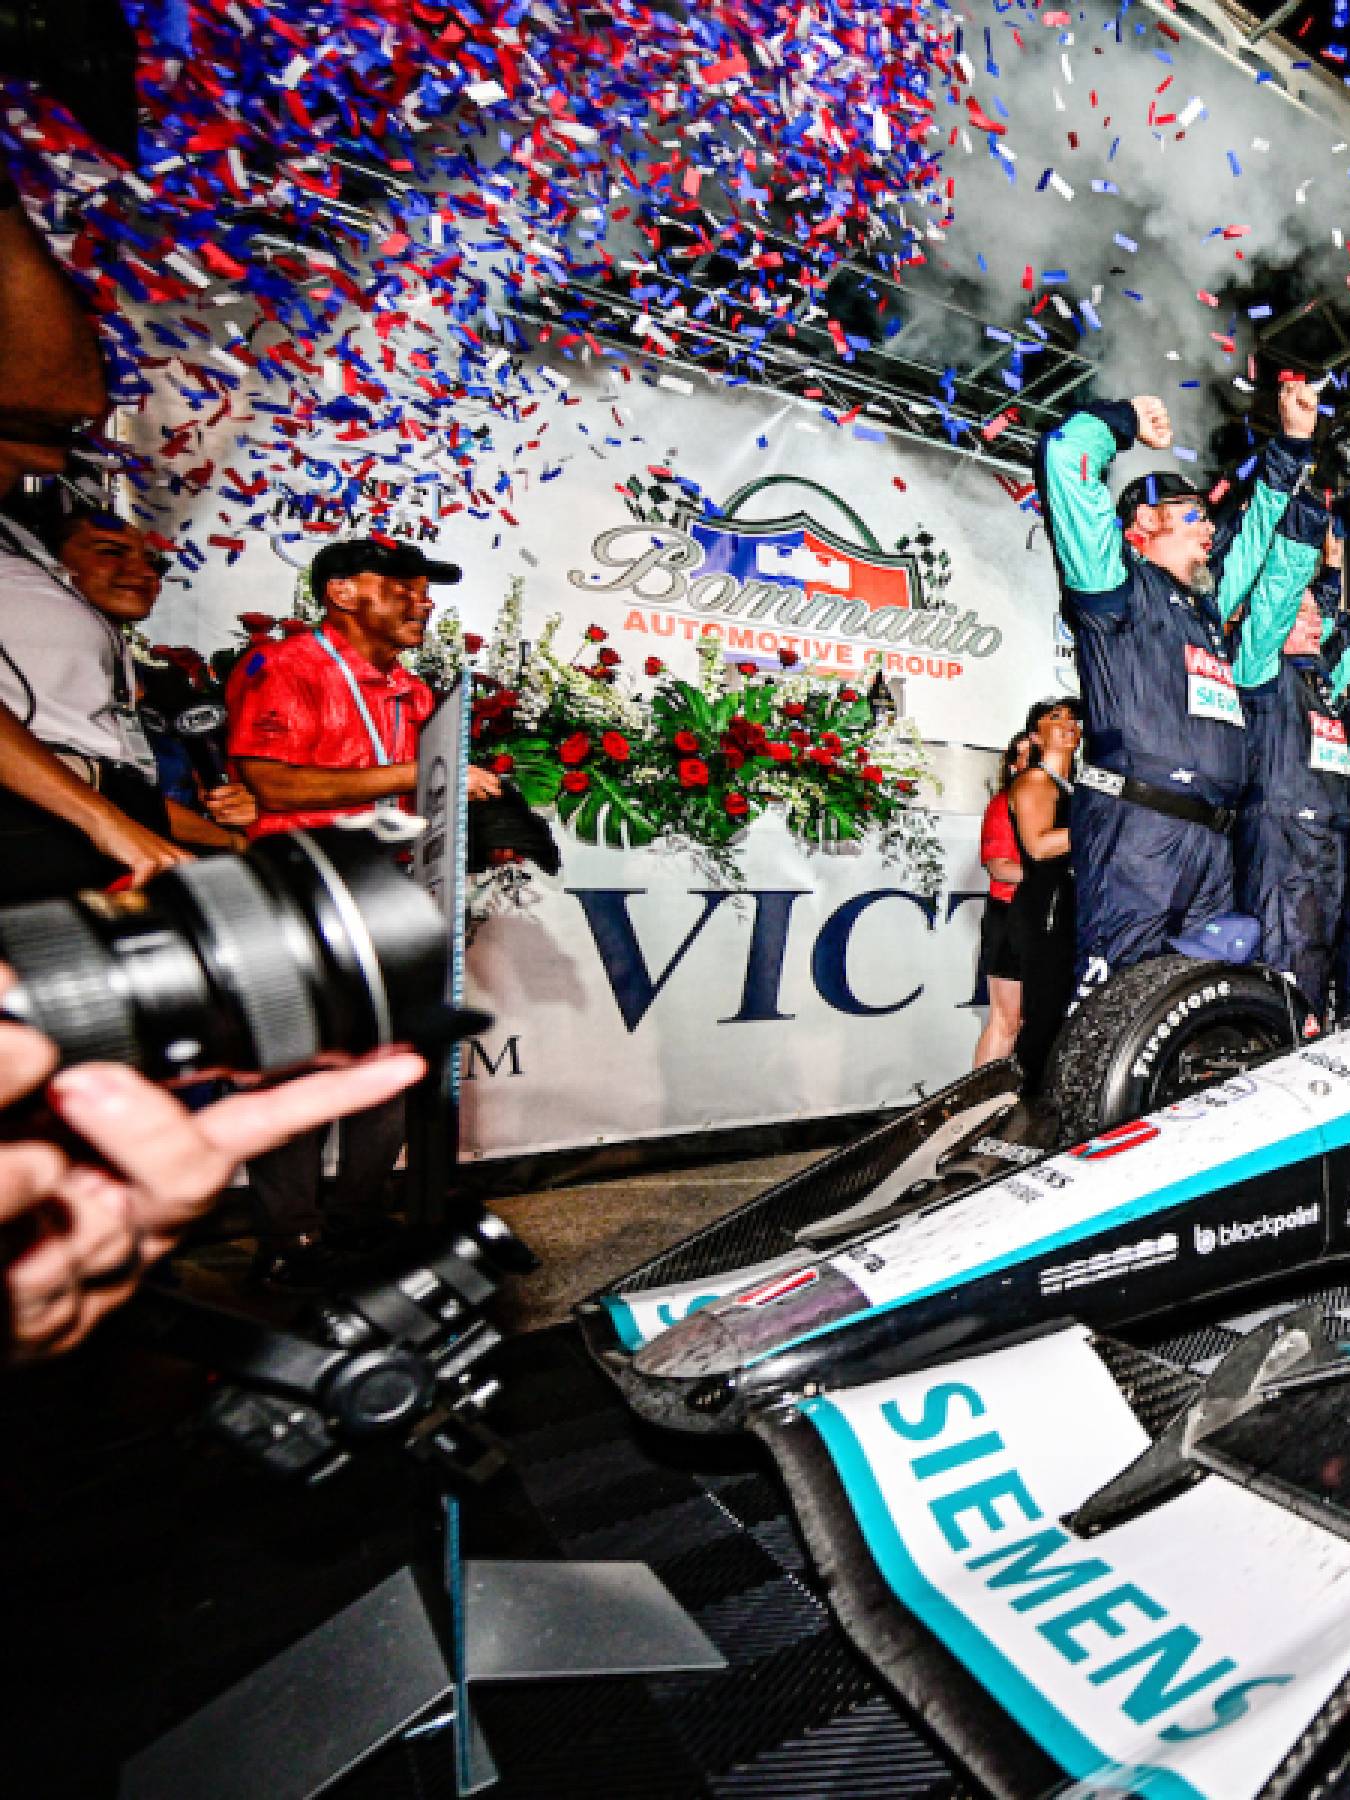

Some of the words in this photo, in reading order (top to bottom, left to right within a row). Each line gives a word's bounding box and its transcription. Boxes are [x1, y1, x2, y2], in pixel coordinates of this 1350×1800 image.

[567, 524, 1002, 658] Bommarito
[863, 647, 964, 681] GROUP
[881, 1382, 1294, 1741] SIEMENS
